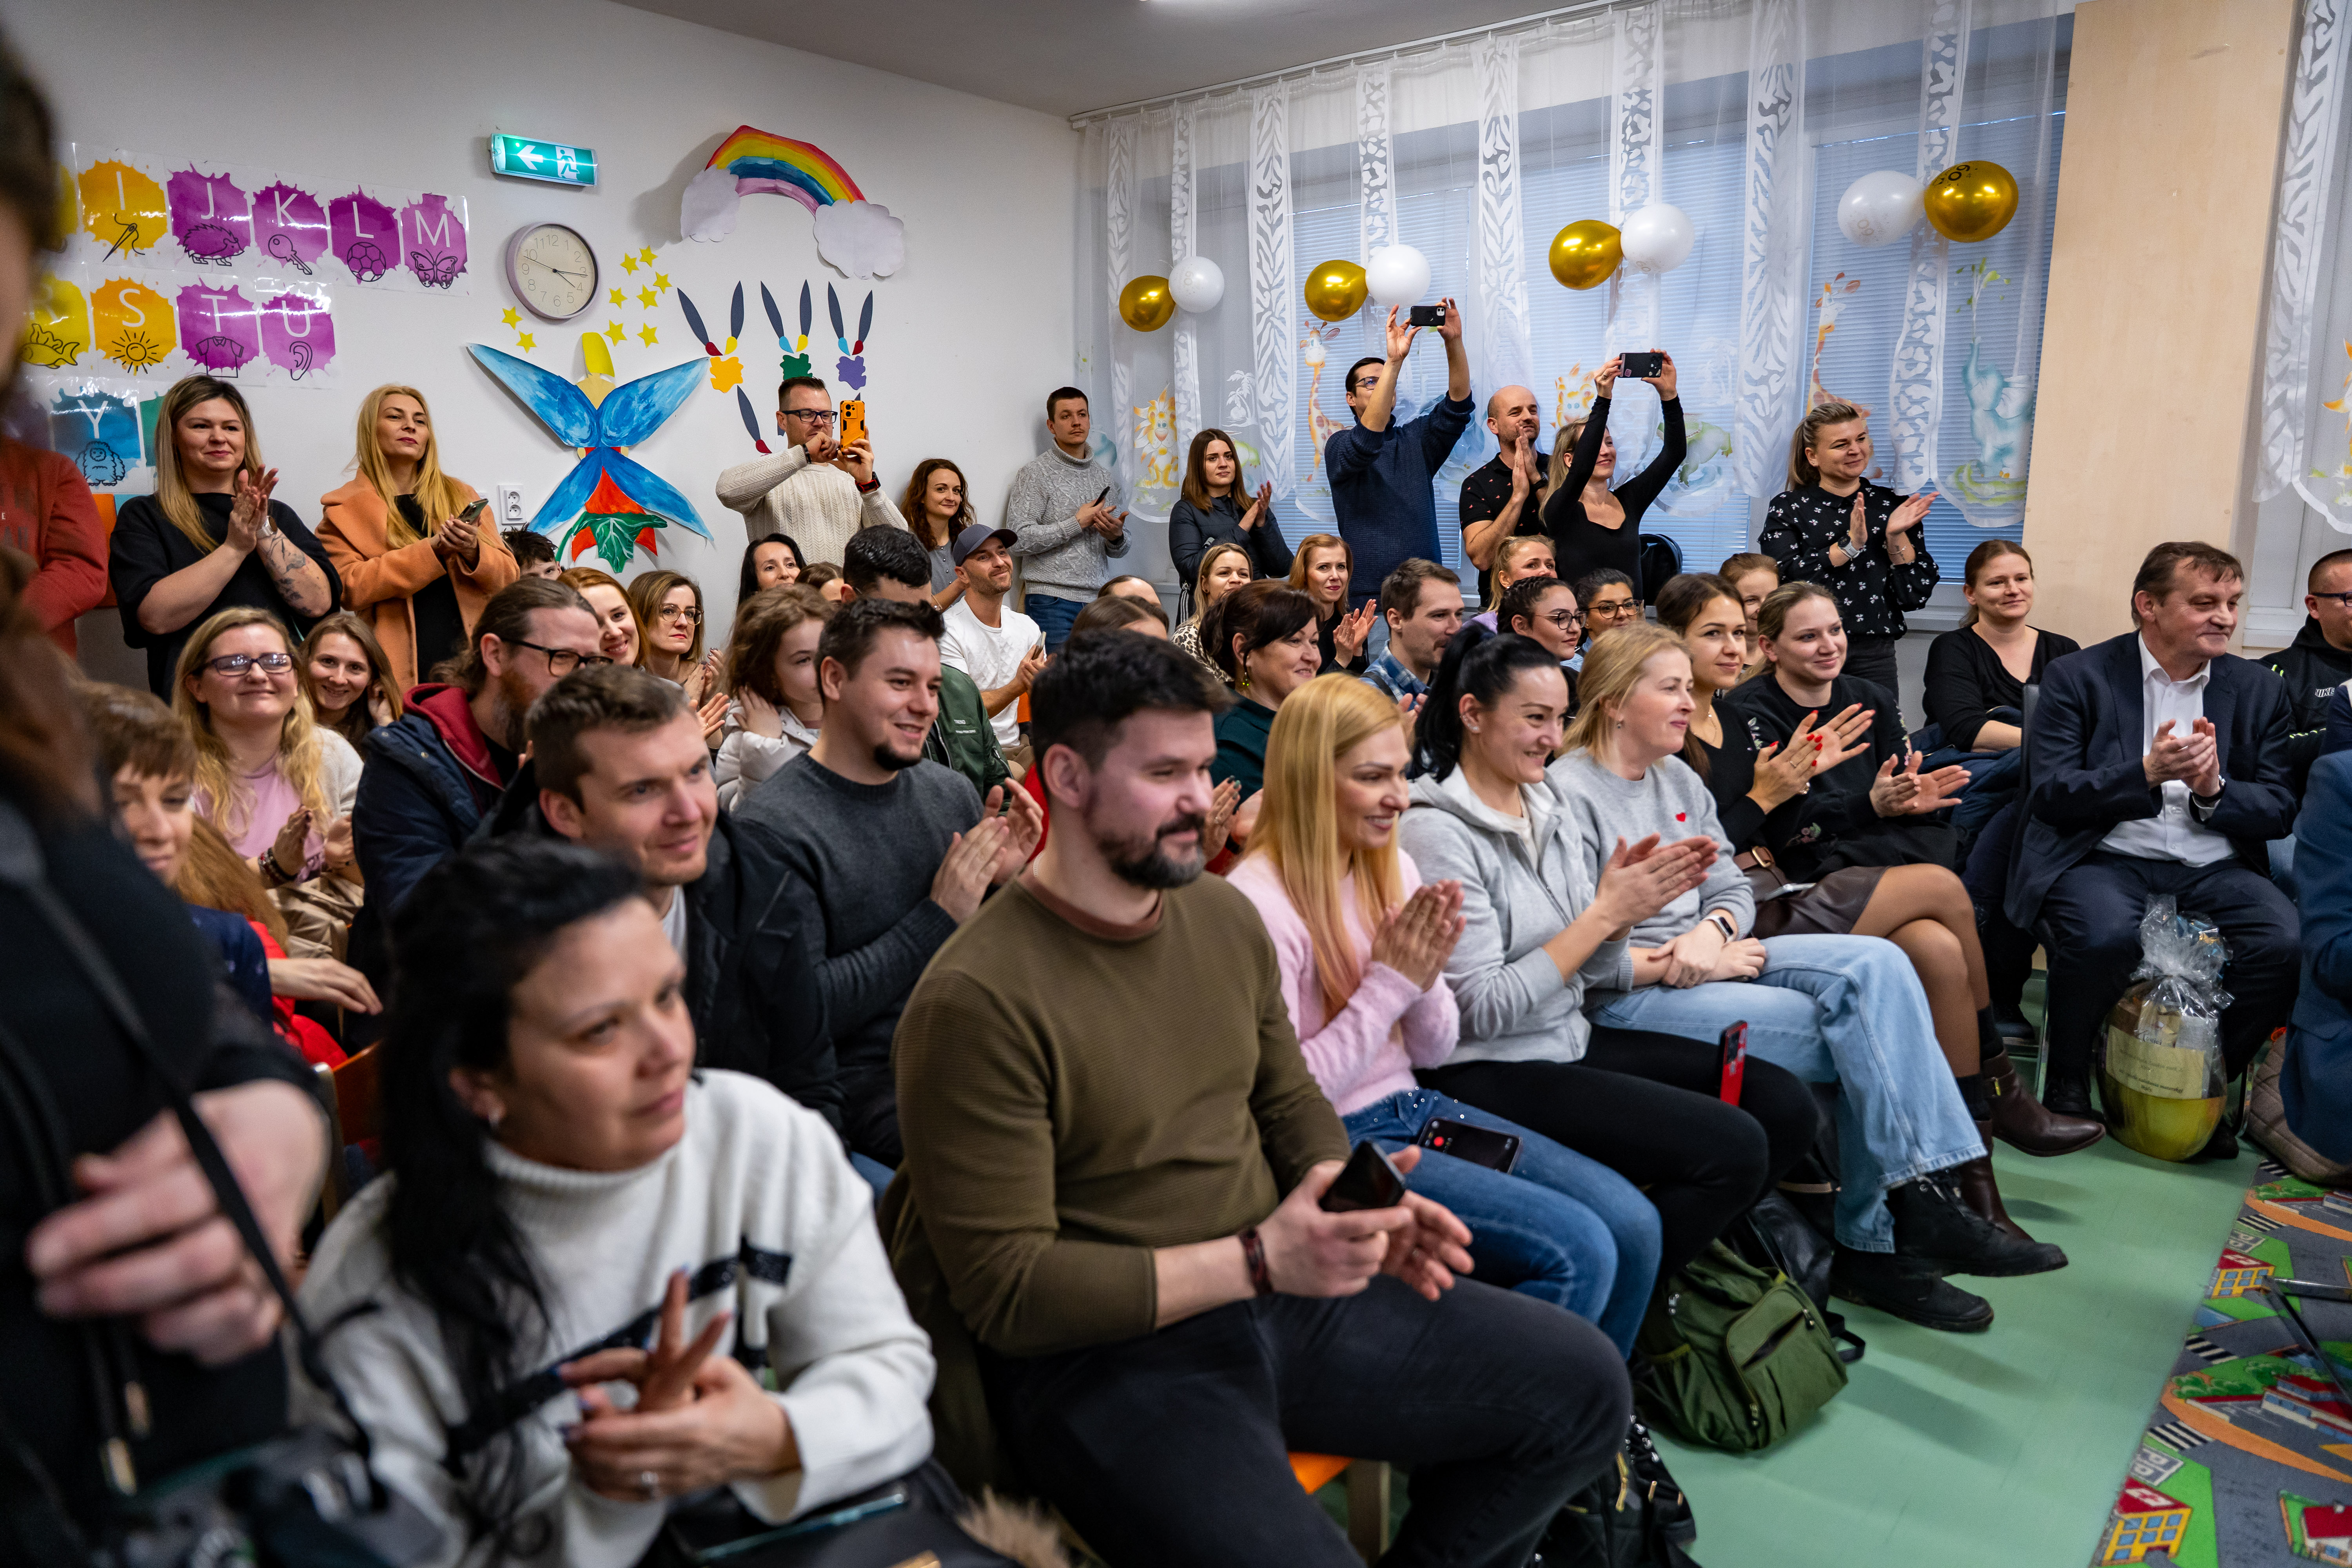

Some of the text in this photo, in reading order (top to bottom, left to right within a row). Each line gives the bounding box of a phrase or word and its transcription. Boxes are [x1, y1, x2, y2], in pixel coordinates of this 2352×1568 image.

[116, 172, 450, 249] I J K L M
[534, 238, 544, 249] 11
[546, 234, 559, 247] 12
[564, 240, 569, 250] 1
[524, 249, 537, 261] 10
[574, 251, 581, 263] 2
[521, 263, 530, 275] 9
[580, 267, 587, 278] 3
[528, 279, 536, 291] 8
[577, 282, 584, 293] 4
[541, 291, 547, 302] 7
[554, 295, 561, 307] 6
[567, 292, 574, 303] 5
[119, 289, 145, 328] S
[201, 295, 228, 332] T
[281, 301, 311, 338] U
[77, 400, 108, 439] Y
[2315, 687, 2335, 697] NIKE
